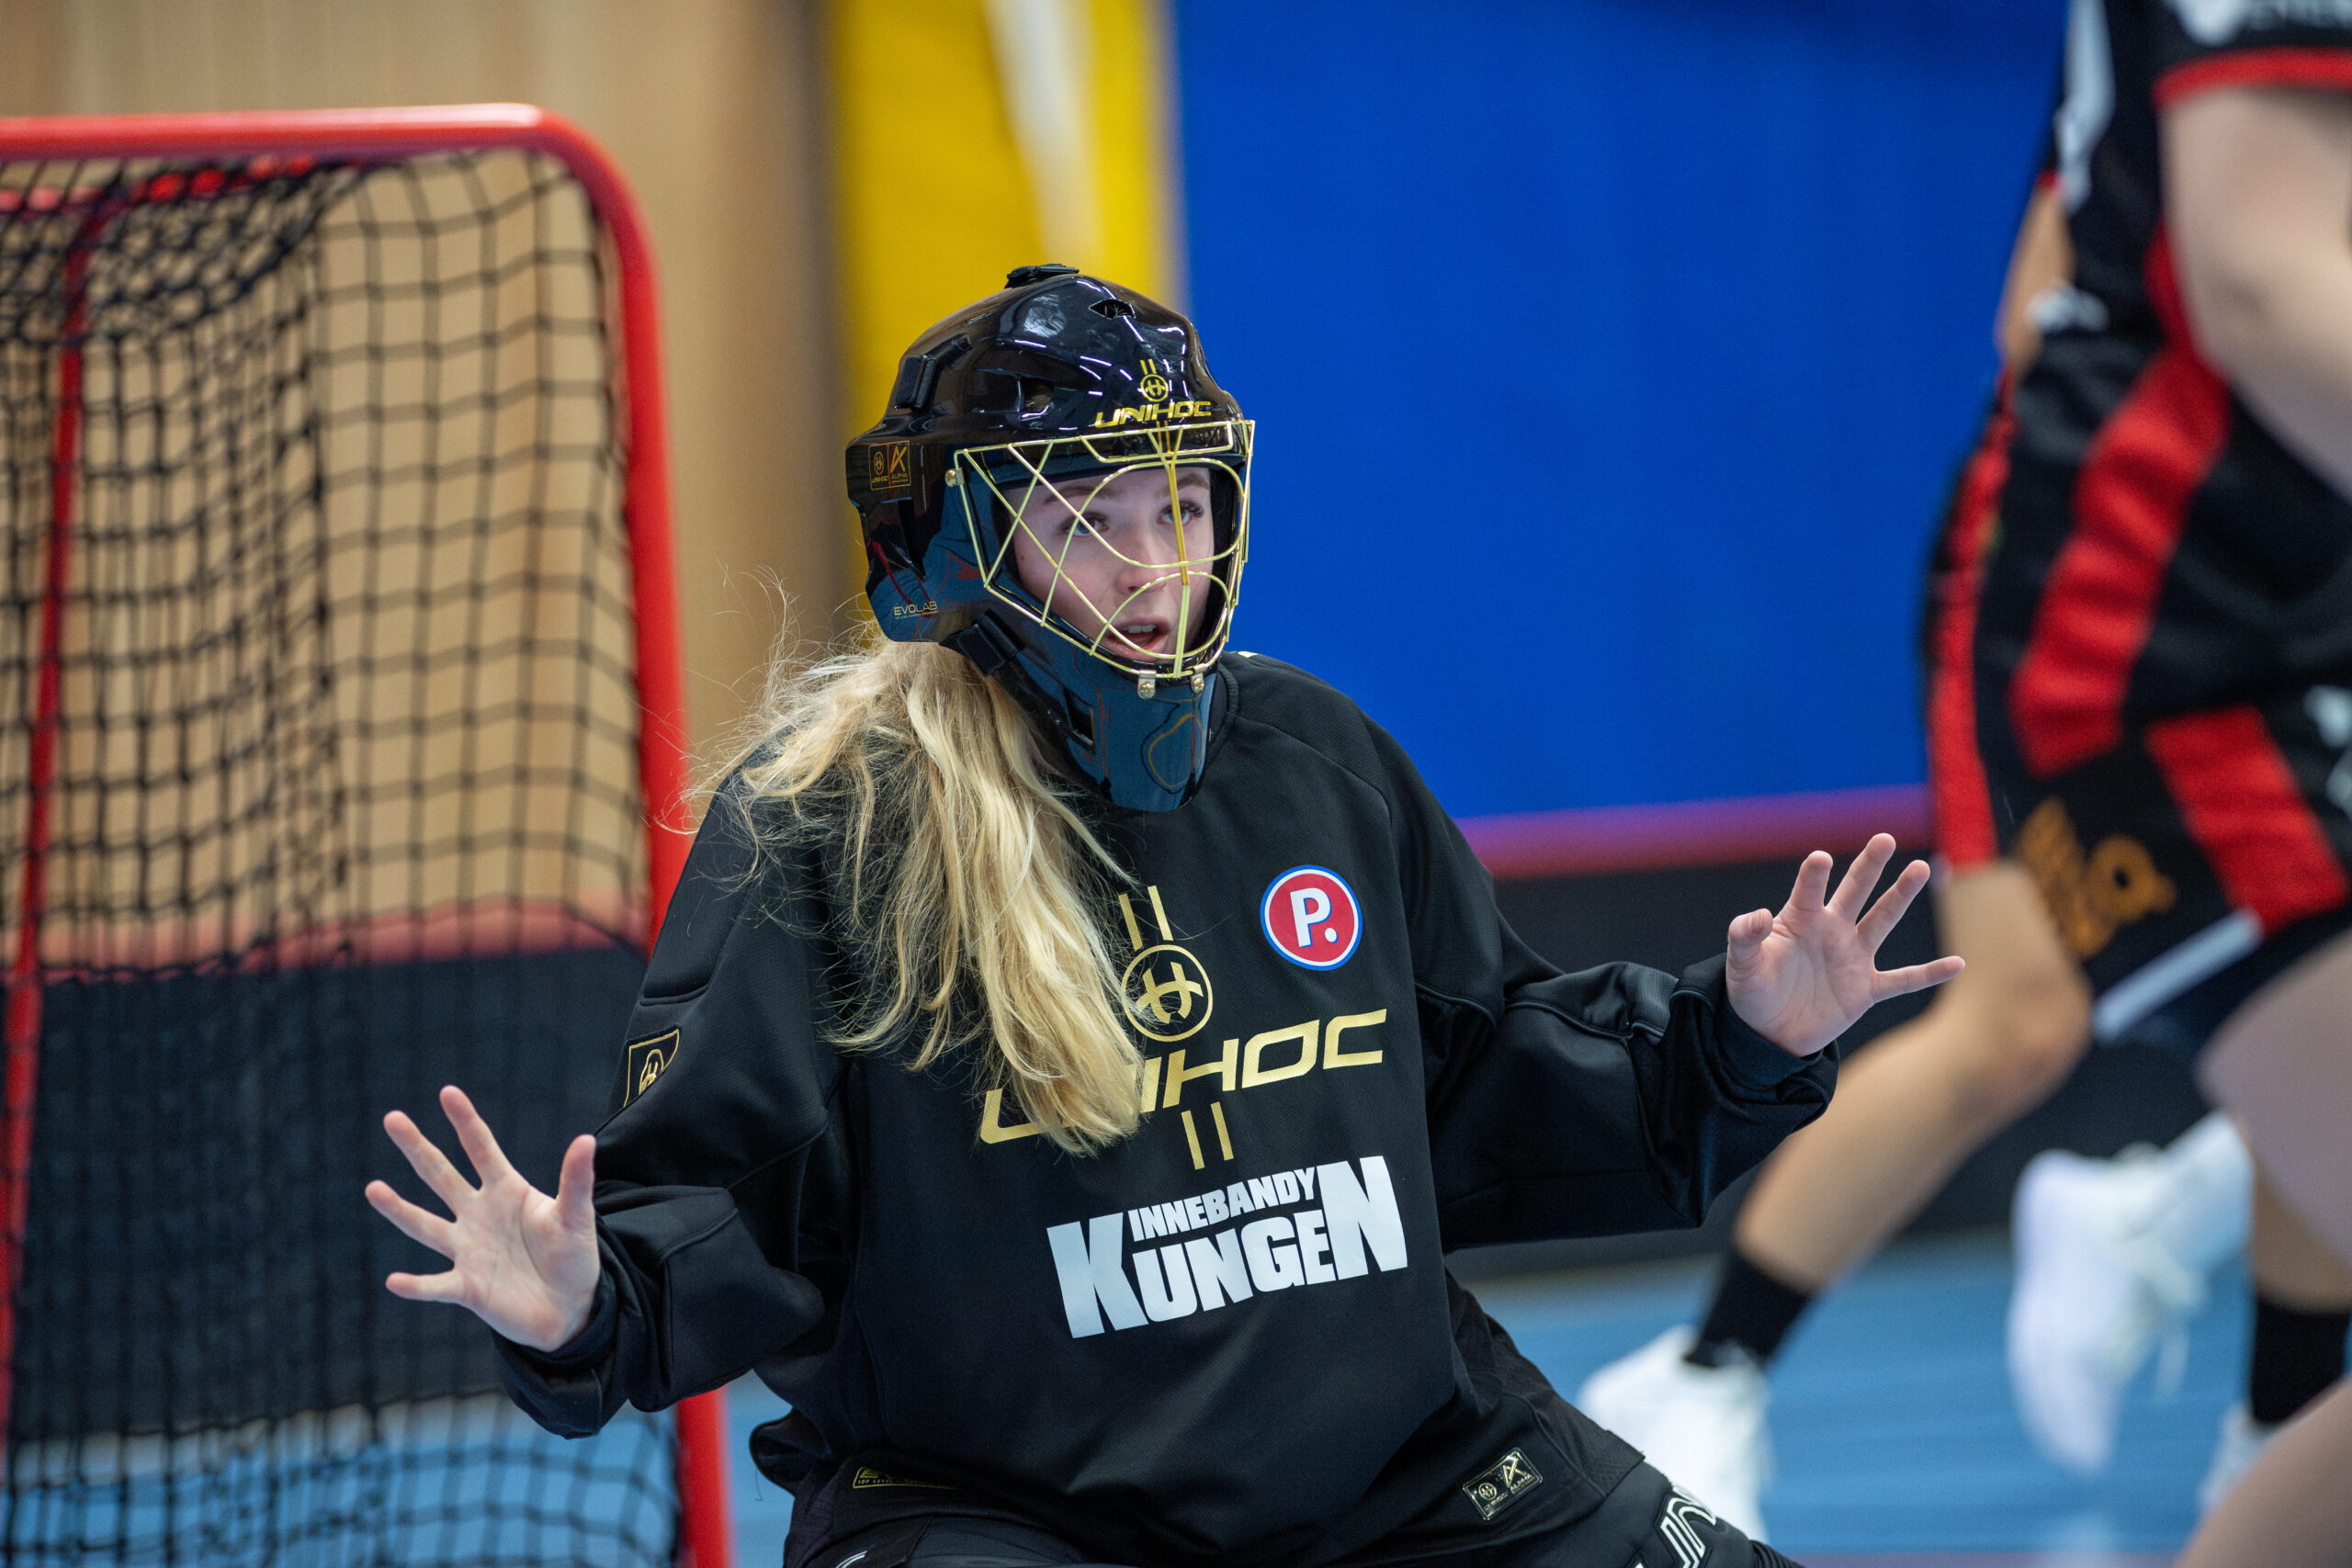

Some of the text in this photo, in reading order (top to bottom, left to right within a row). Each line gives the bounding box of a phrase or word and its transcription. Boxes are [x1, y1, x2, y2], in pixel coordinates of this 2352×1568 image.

[1094, 400, 1212, 428] UNIHOC
[894, 601, 938, 615] EVOLAB
[1290, 887, 1339, 948] P.
[979, 1009, 1387, 1145] UIHOC
[1127, 1167, 1316, 1242] INNEBANDY
[1046, 1155, 1408, 1339] KUNGEN
